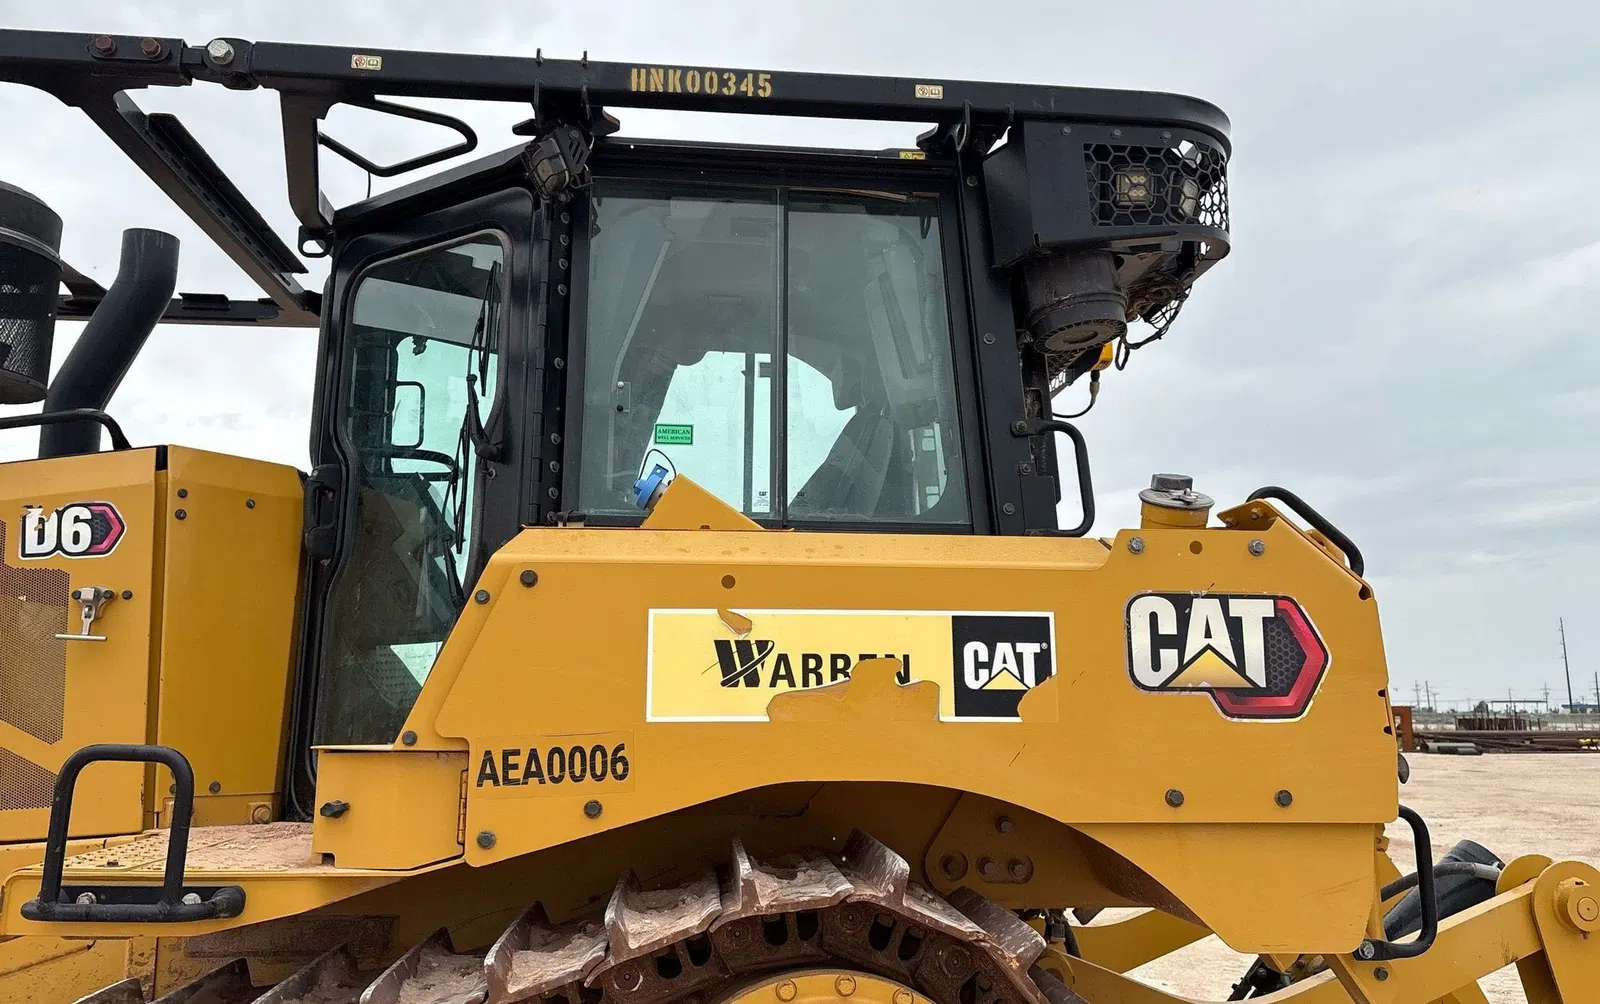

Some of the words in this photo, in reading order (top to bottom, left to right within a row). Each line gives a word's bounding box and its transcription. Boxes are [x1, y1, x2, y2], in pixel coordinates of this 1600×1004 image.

[631, 67, 772, 98] HNK00345
[25, 506, 92, 554] D6
[713, 639, 910, 688] WARRN
[1129, 595, 1275, 688] CAT
[476, 743, 630, 787] AEA0006
